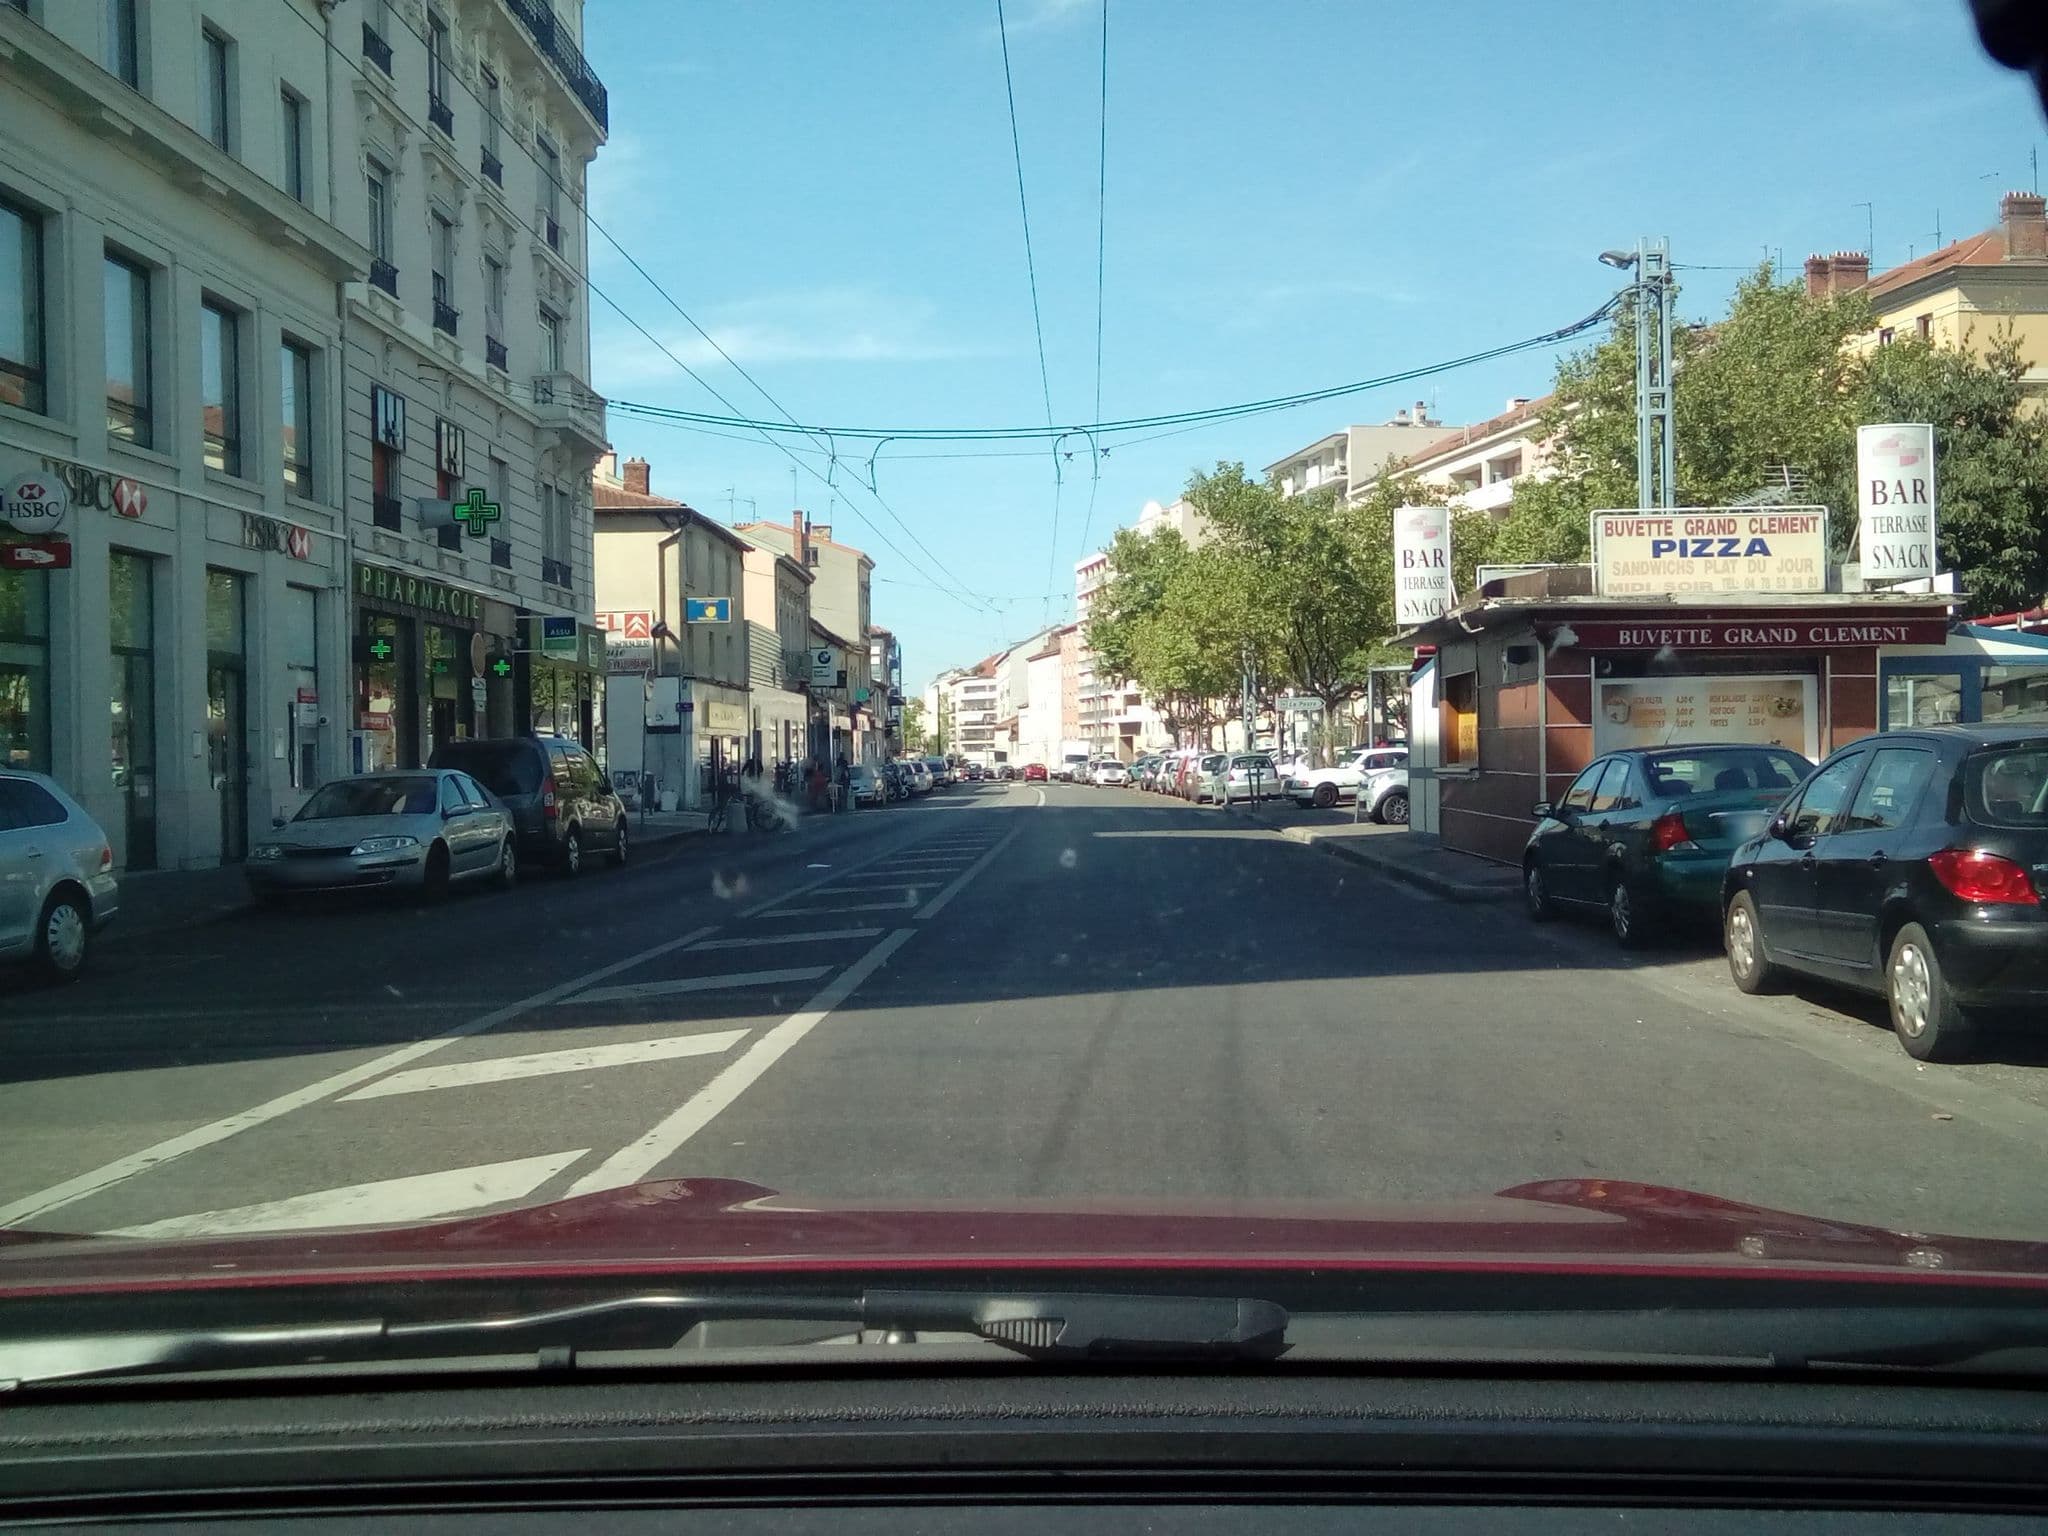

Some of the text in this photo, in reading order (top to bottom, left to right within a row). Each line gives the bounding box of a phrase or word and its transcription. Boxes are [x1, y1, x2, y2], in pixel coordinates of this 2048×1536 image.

[1871, 478, 1929, 506] BAR
[8, 501, 60, 519] HSBC
[1604, 515, 1819, 537] BUVETTE GRAND CLEMENT
[1871, 515, 1929, 534] TERRASSE
[1402, 547, 1447, 569] BAR
[1652, 537, 1772, 559] PIZZA
[1872, 543, 1929, 569] SNACK
[1611, 557, 1814, 577] SANDWICHS PLAT DU JOUR
[361, 566, 481, 619] PHARMACIE
[1402, 575, 1447, 591] TERRASSE
[1403, 597, 1447, 618] SNACK
[1618, 625, 1909, 645] BUVETTE GRAND CLEMENT
